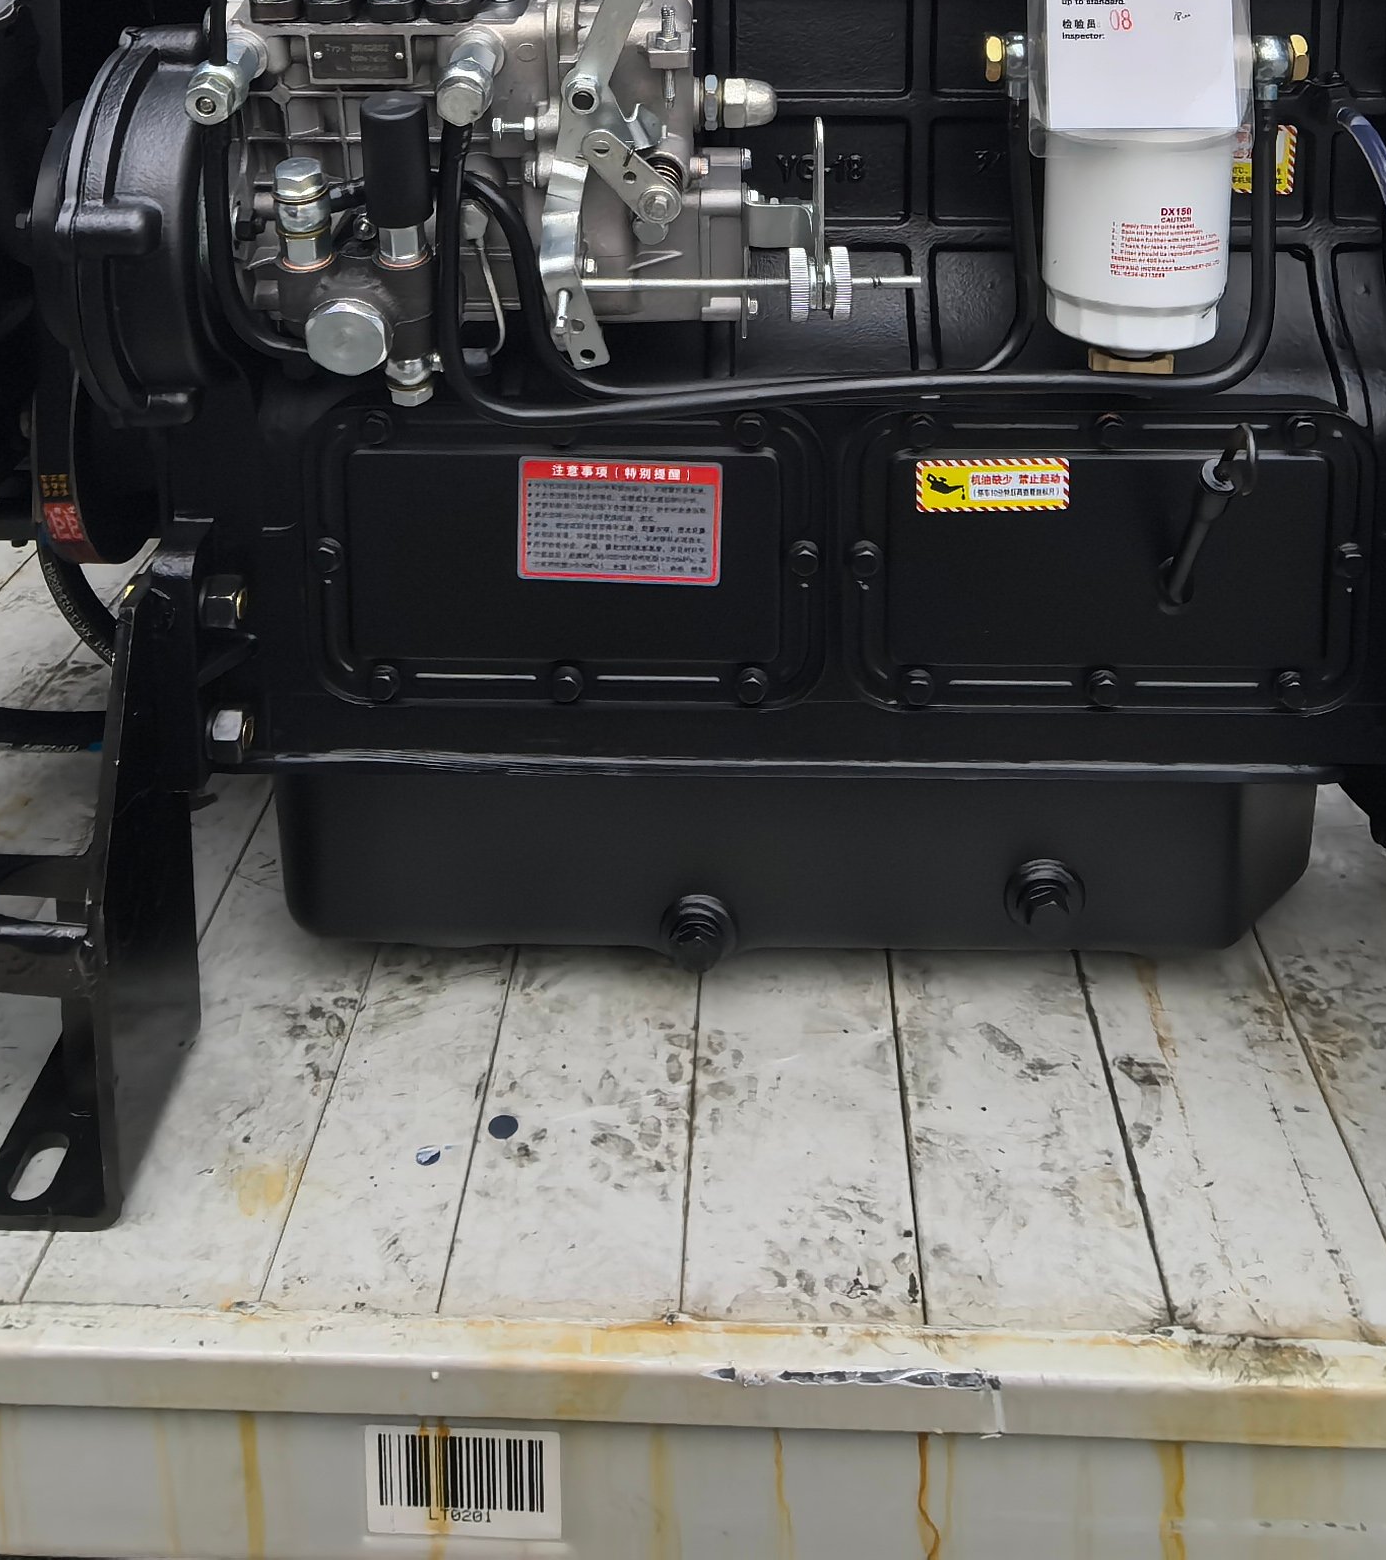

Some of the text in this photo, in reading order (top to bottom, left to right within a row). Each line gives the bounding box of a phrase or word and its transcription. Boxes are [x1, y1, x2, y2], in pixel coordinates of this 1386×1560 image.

[1109, 9, 1132, 30] 08
[1062, 32, 1105, 41] Inspector:
[428, 1508, 492, 1523] LT0201
